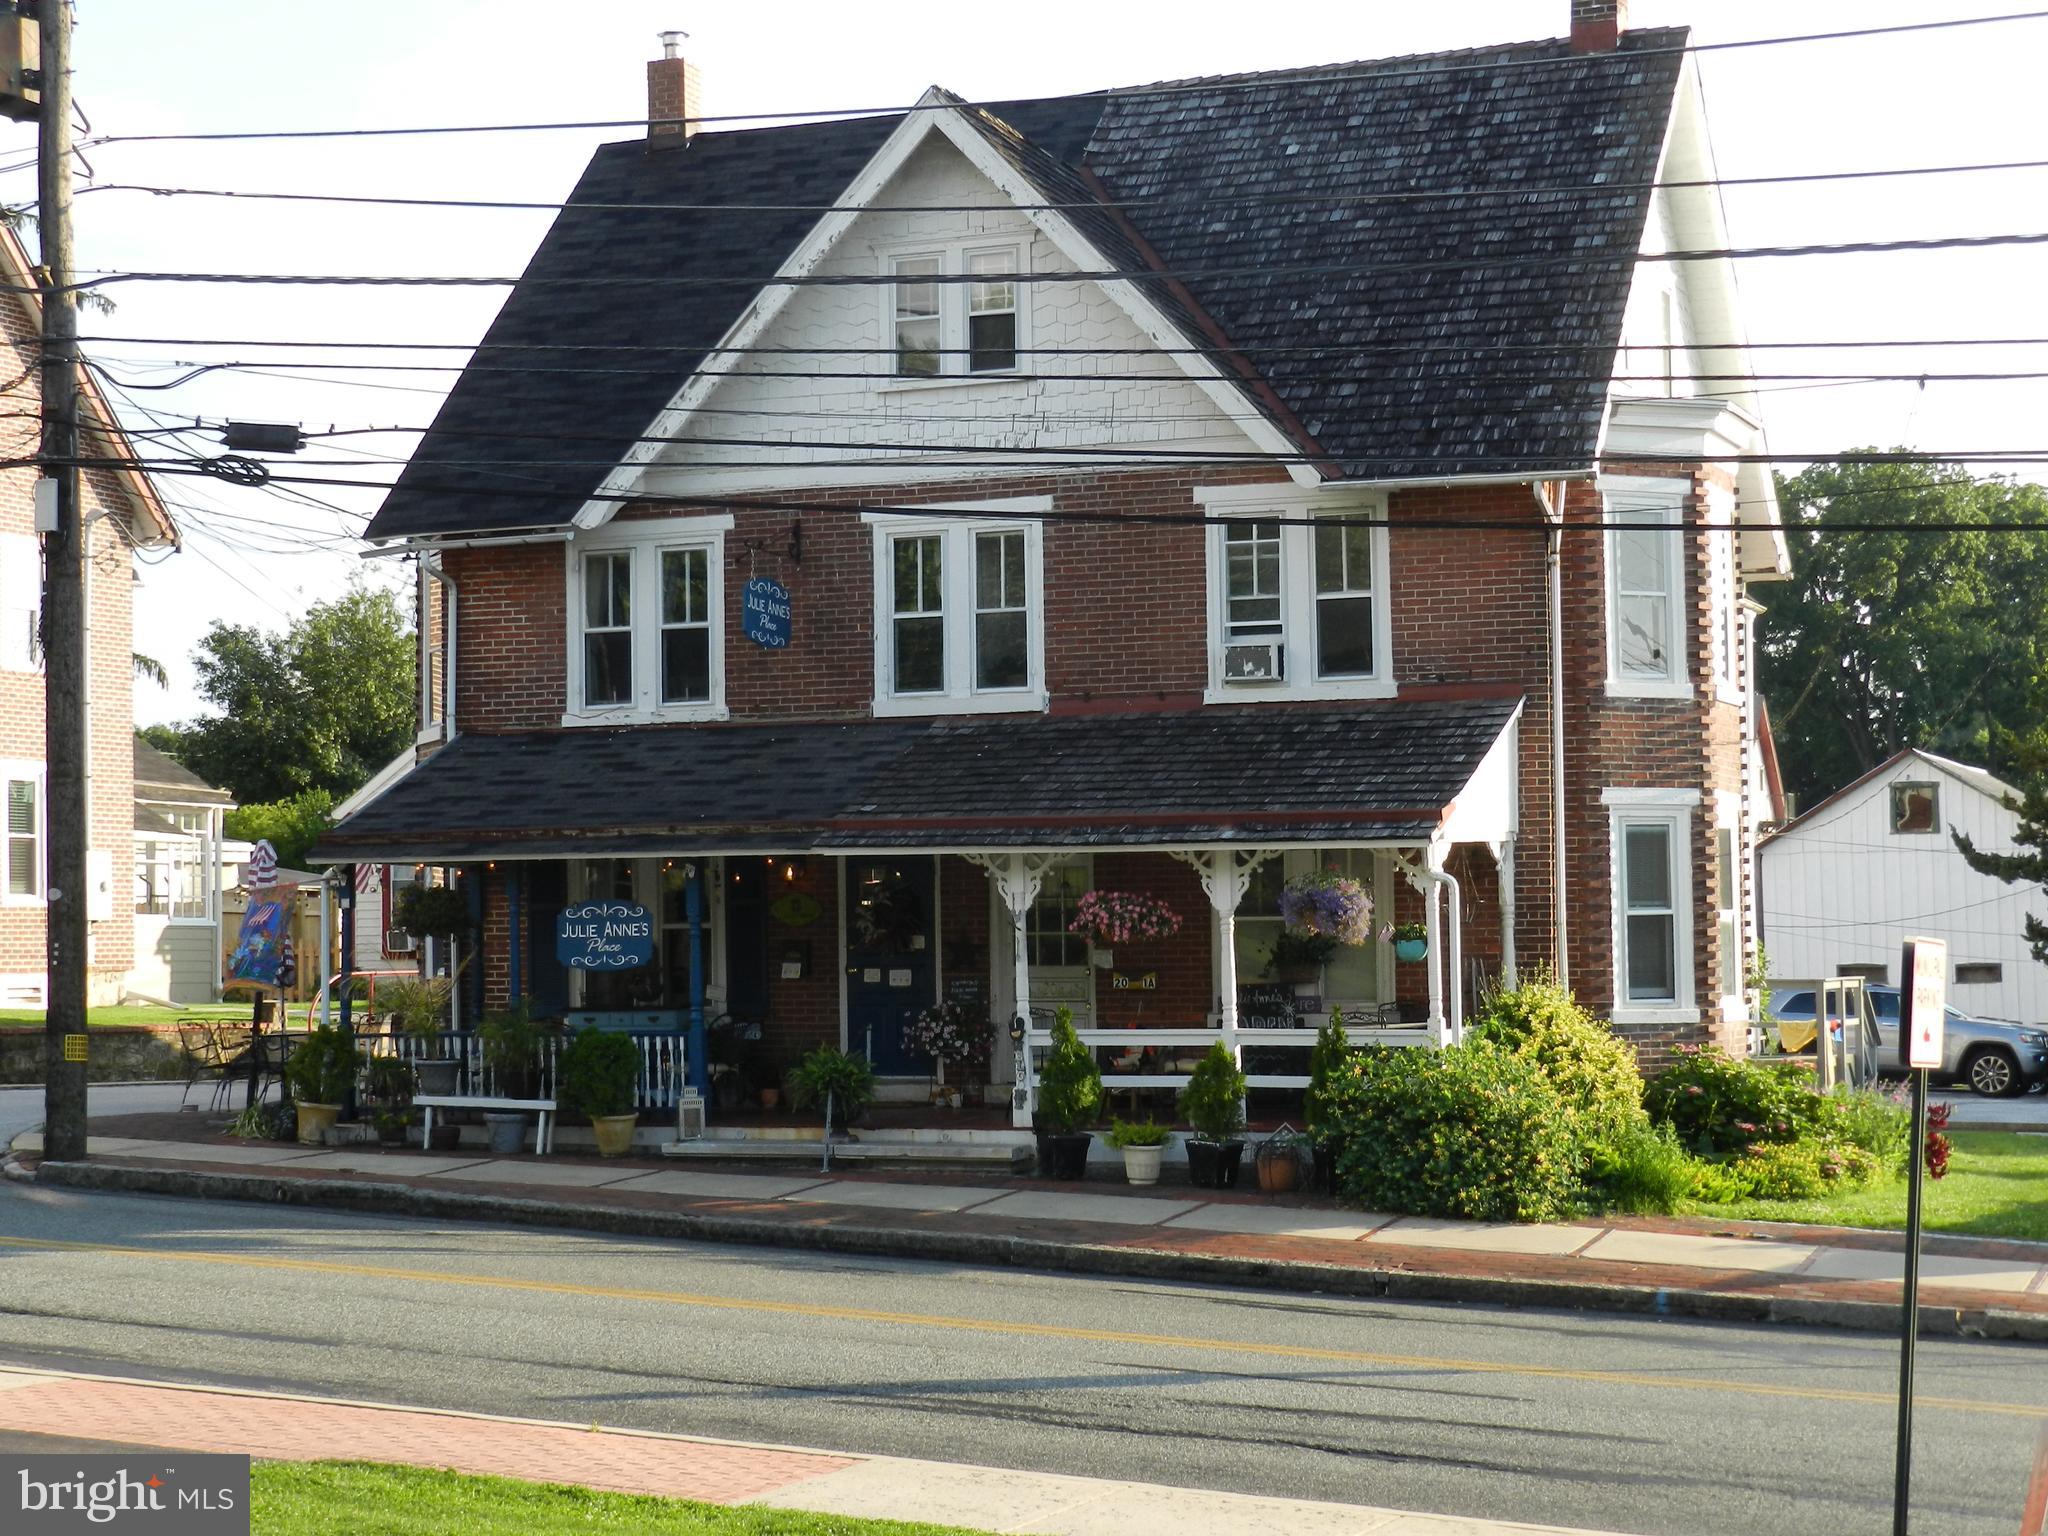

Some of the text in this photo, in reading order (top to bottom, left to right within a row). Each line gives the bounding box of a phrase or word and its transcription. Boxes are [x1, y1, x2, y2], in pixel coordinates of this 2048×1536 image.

[760, 614, 777, 631] Place
[562, 921, 649, 938] JULIE ANNE'S
[587, 938, 622, 953] Place
[1114, 978, 1128, 988] 20
